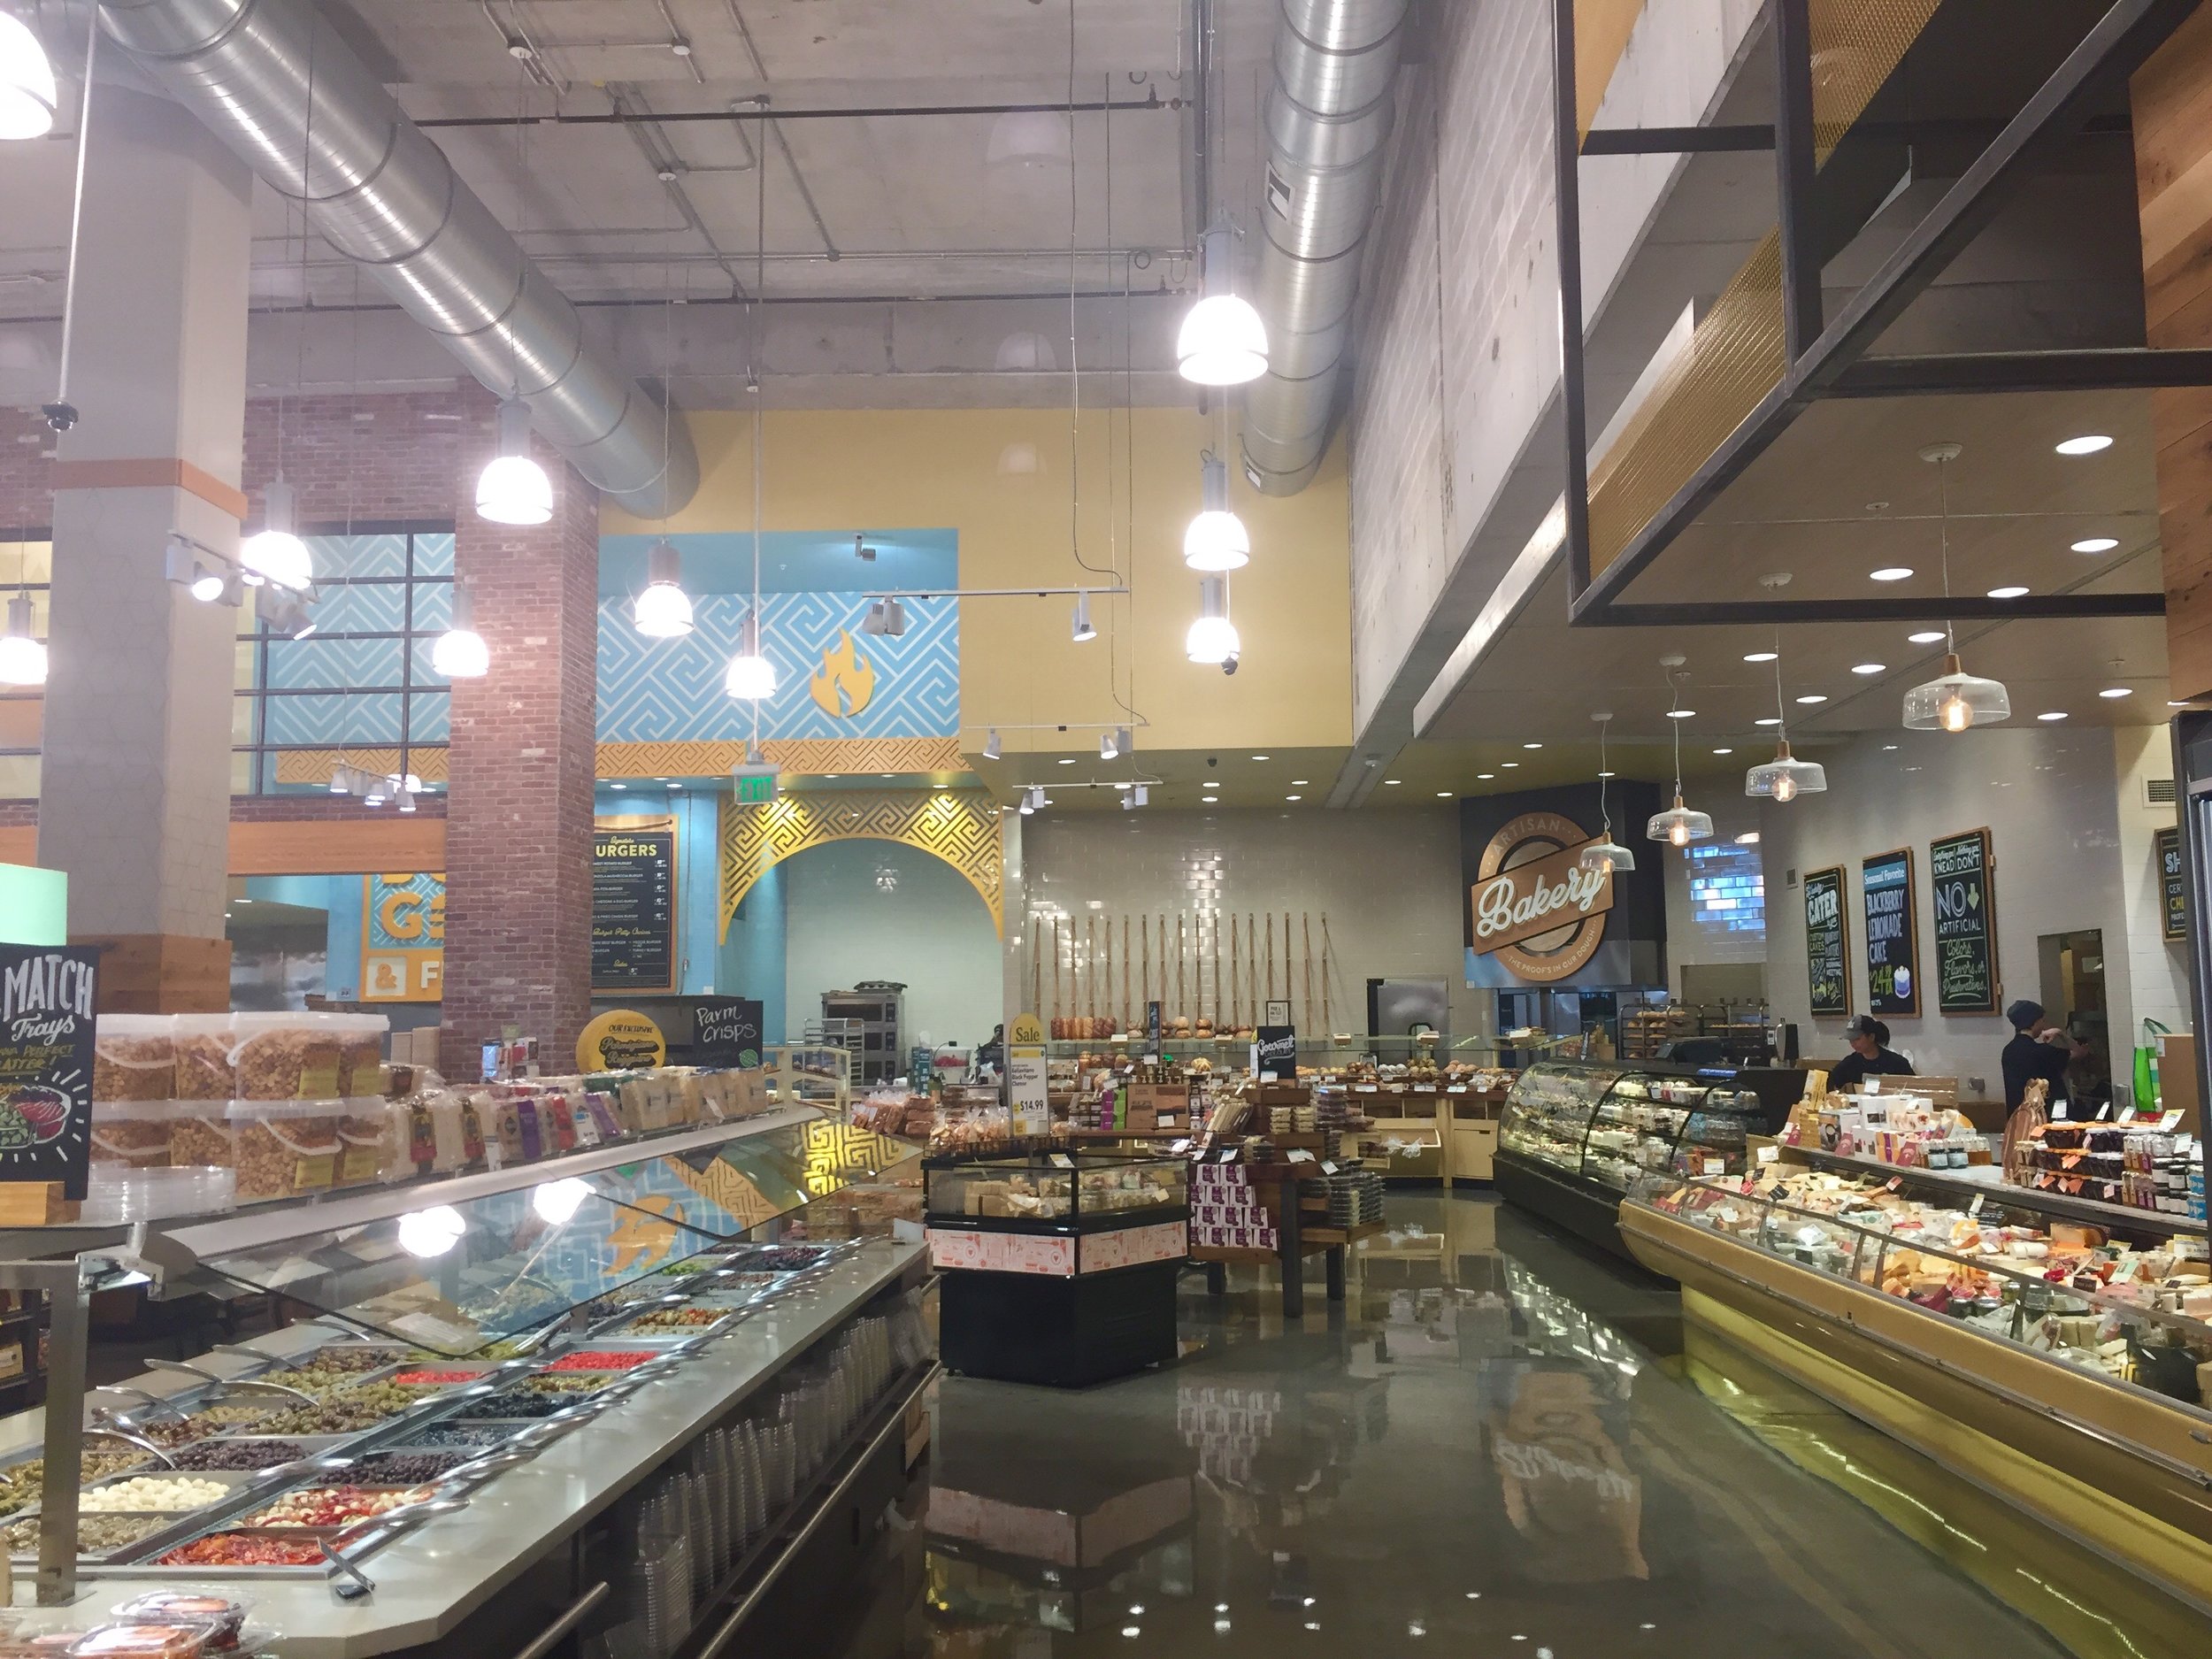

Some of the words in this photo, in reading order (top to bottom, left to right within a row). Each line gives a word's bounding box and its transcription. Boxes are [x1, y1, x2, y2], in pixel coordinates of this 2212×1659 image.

[741, 776, 772, 801] EXIT
[1493, 818, 1561, 856] ARTISAN
[595, 844, 657, 857] URGERS
[1864, 871, 1885, 885] Seasonal
[1885, 868, 1905, 882] Favorite
[1934, 859, 1955, 874] KNEAD
[1957, 855, 1979, 870] DON'T
[1936, 881, 1966, 920] NO
[2169, 883, 2182, 894] CER
[1477, 867, 1606, 938] Bakery
[1808, 889, 1839, 926] CATER
[1866, 889, 1905, 917] BLACKBERRY
[1868, 913, 1903, 941] LEMONADE
[1939, 918, 1981, 935] ARTIFICIAL
[1509, 956, 1520, 969] THE
[1563, 955, 1578, 969] OUR
[1577, 929, 1597, 957] DOUGH
[1869, 941, 1888, 964] CAKE
[375, 963, 397, 989] &
[421, 961, 444, 989] F
[3, 954, 94, 1022] MATCH
[695, 1005, 743, 1027] Parm
[12, 1012, 75, 1046] Trays
[608, 1024, 622, 1033] OUR
[1016, 1027, 1041, 1042] Sale
[1257, 1033, 1295, 1056] Gourmet
[1020, 1099, 1044, 1111] $14.99
